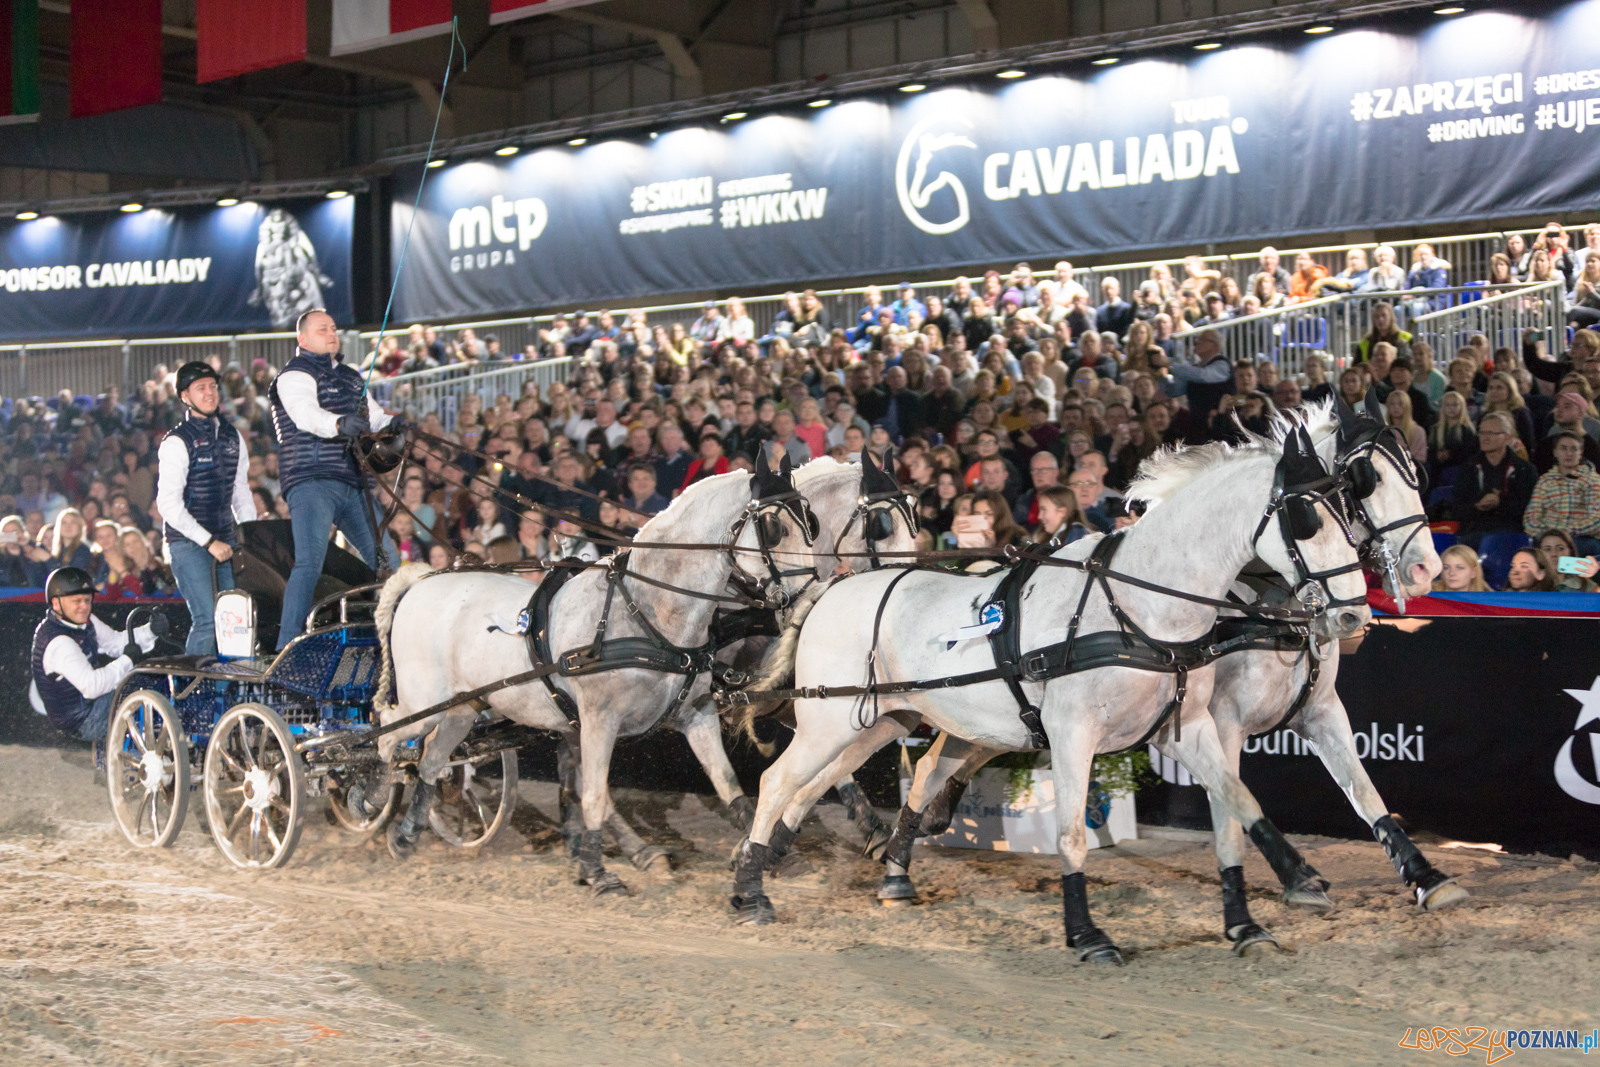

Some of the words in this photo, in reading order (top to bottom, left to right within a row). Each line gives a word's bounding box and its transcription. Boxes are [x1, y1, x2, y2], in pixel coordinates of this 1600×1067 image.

[1350, 72, 1523, 122] #ZAPRZĘGI
[1533, 68, 1600, 96] #DRES
[1171, 95, 1230, 125] TOUR
[1427, 113, 1525, 143] #DRIVING
[1535, 98, 1600, 134] #UJE
[983, 125, 1241, 201] CAVALIADA
[630, 176, 713, 213] #SKOKI
[719, 187, 828, 229] #WKKW
[448, 194, 549, 252] mtp
[85, 257, 212, 288] CAVALIADY
[450, 249, 516, 274] GRUPA
[1353, 721, 1425, 762] olski
